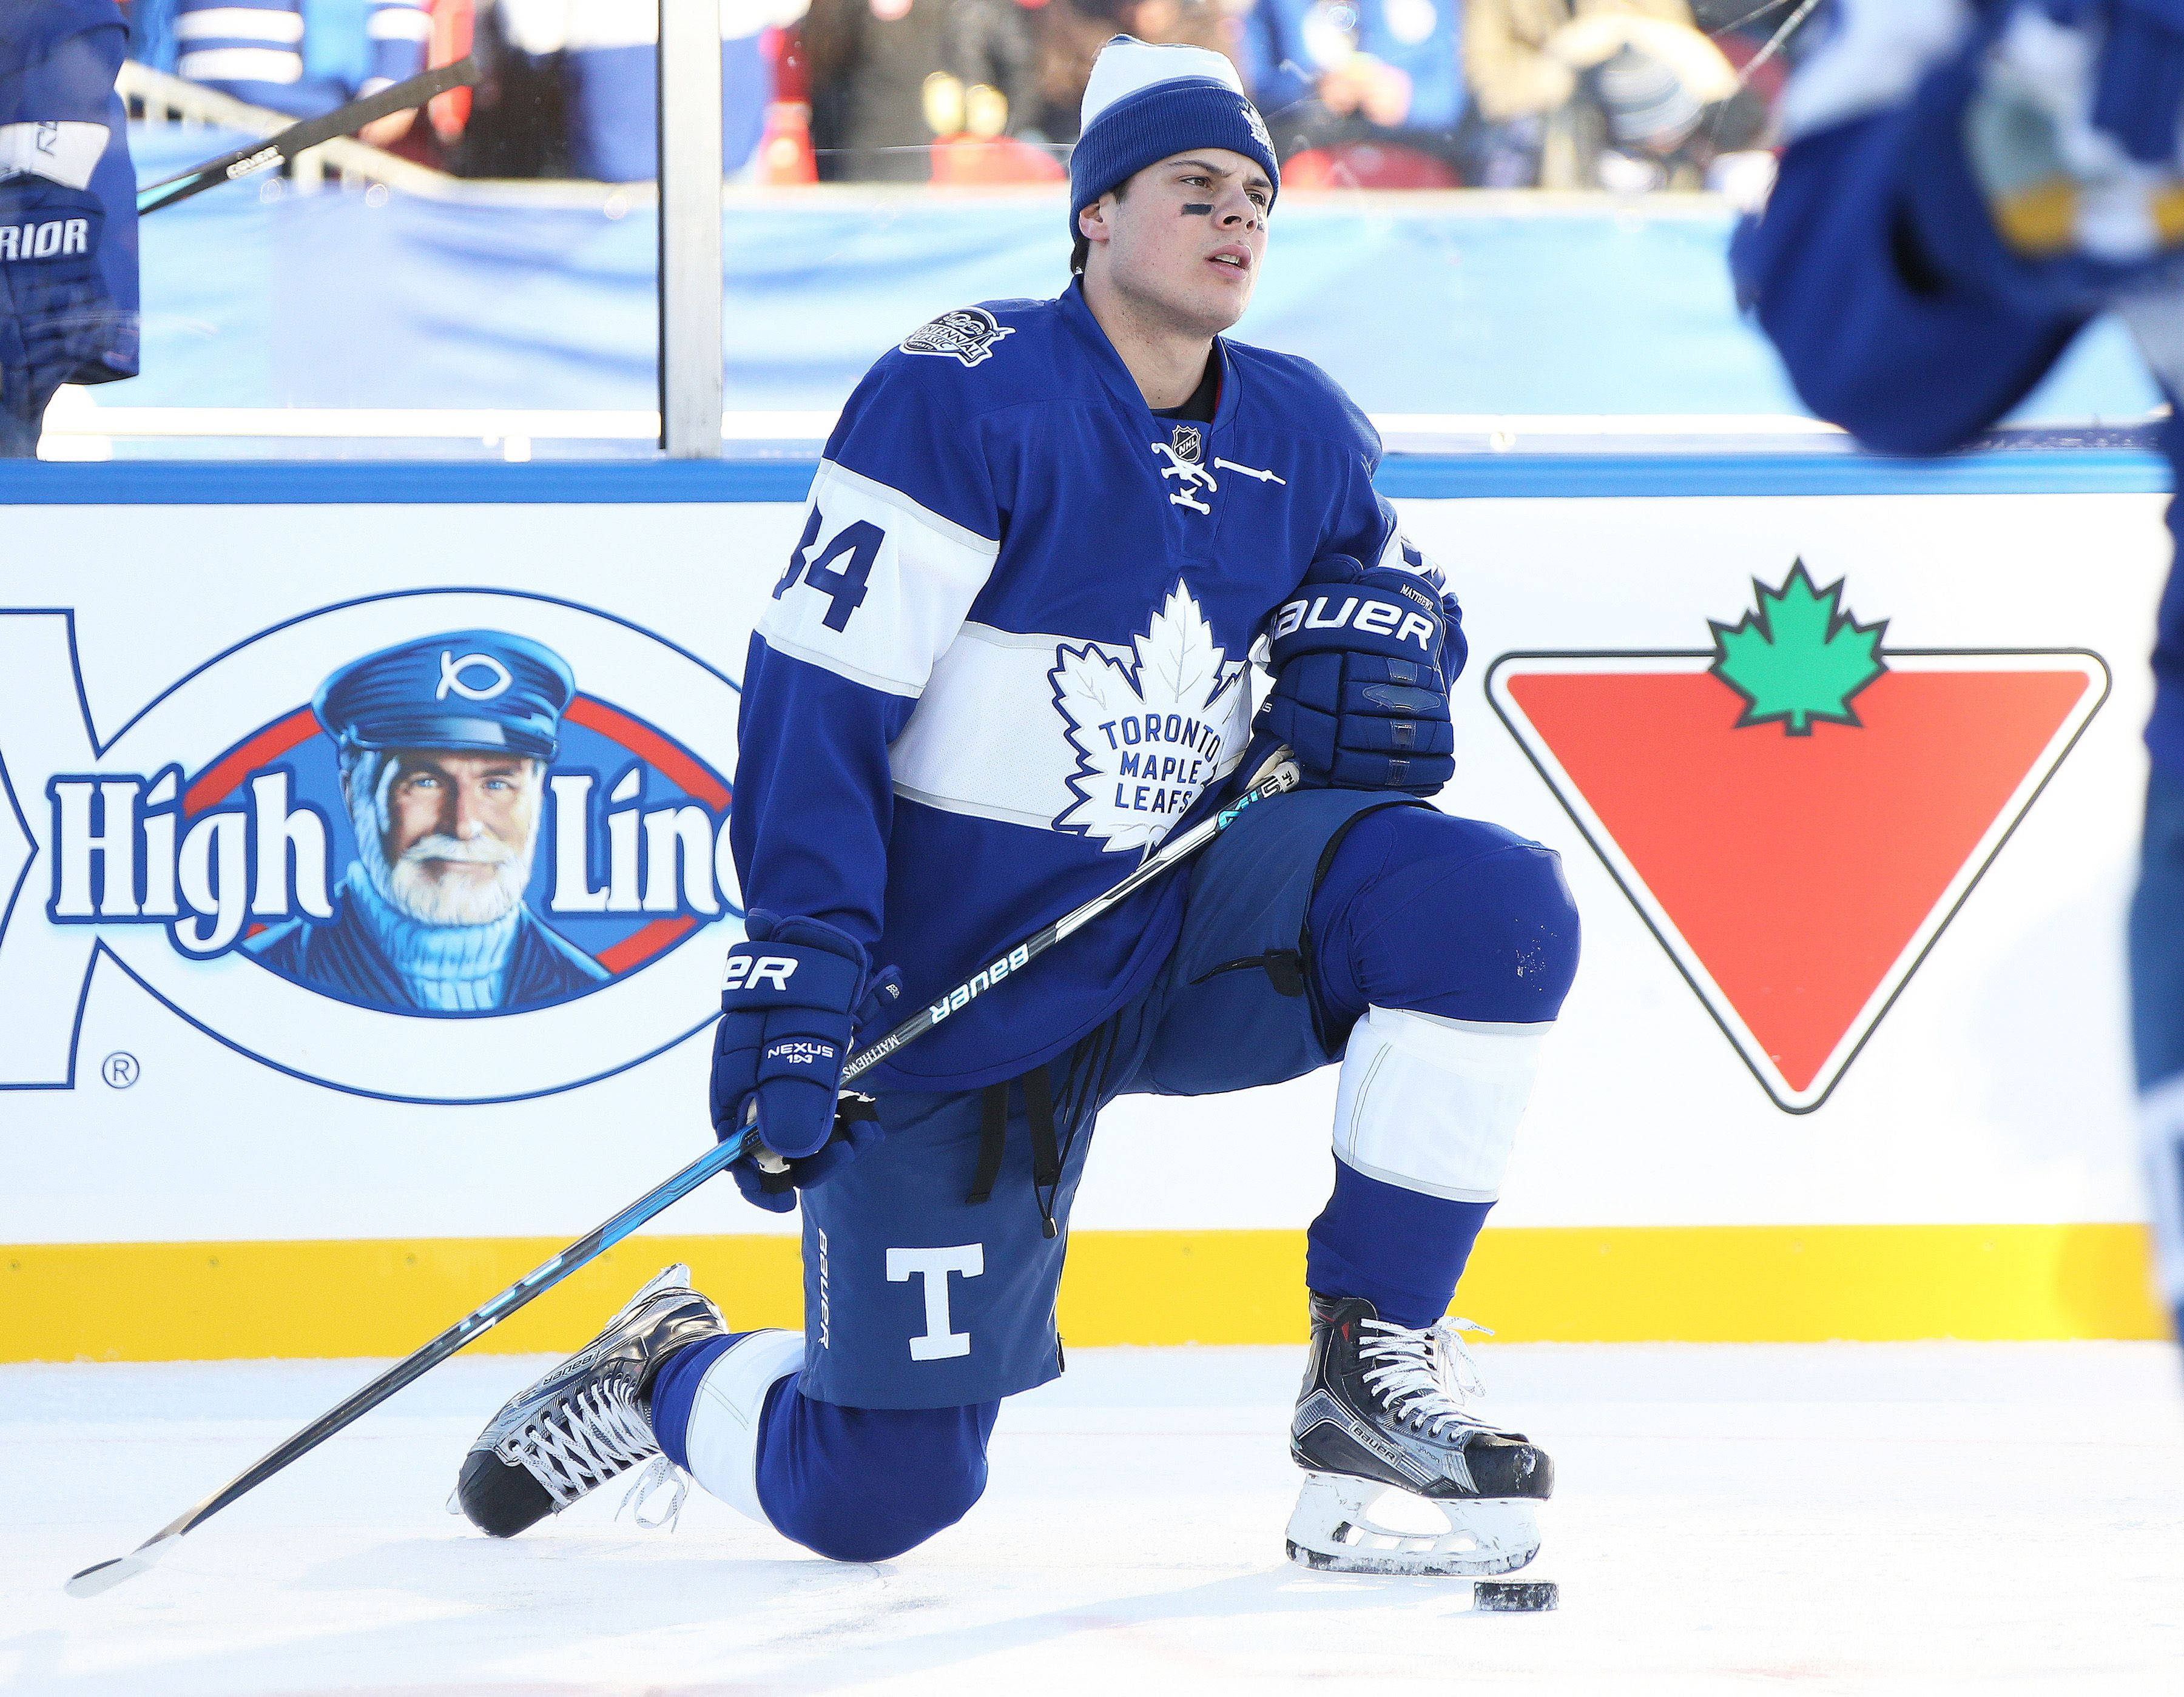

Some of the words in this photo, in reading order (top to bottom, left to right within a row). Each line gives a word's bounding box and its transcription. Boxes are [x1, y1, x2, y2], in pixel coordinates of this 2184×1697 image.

[916, 325, 980, 357] ENTENNIAL
[1179, 437, 1196, 455] NHL
[1400, 583, 1434, 610] MATTHEWS
[1098, 713, 1221, 762] TORONTO
[1119, 750, 1202, 784] MAPLE
[1114, 783, 1192, 813] LEAFS
[49, 766, 335, 957] High
[929, 943, 1030, 1025] BAUER
[767, 1043, 835, 1059] NEXUS
[842, 1033, 901, 1080] MATTHEWS
[818, 1228, 829, 1349] BAUER
[885, 1242, 984, 1362] T
[544, 1354, 595, 1386] BAUER
[1353, 1426, 1396, 1462] BAUER
